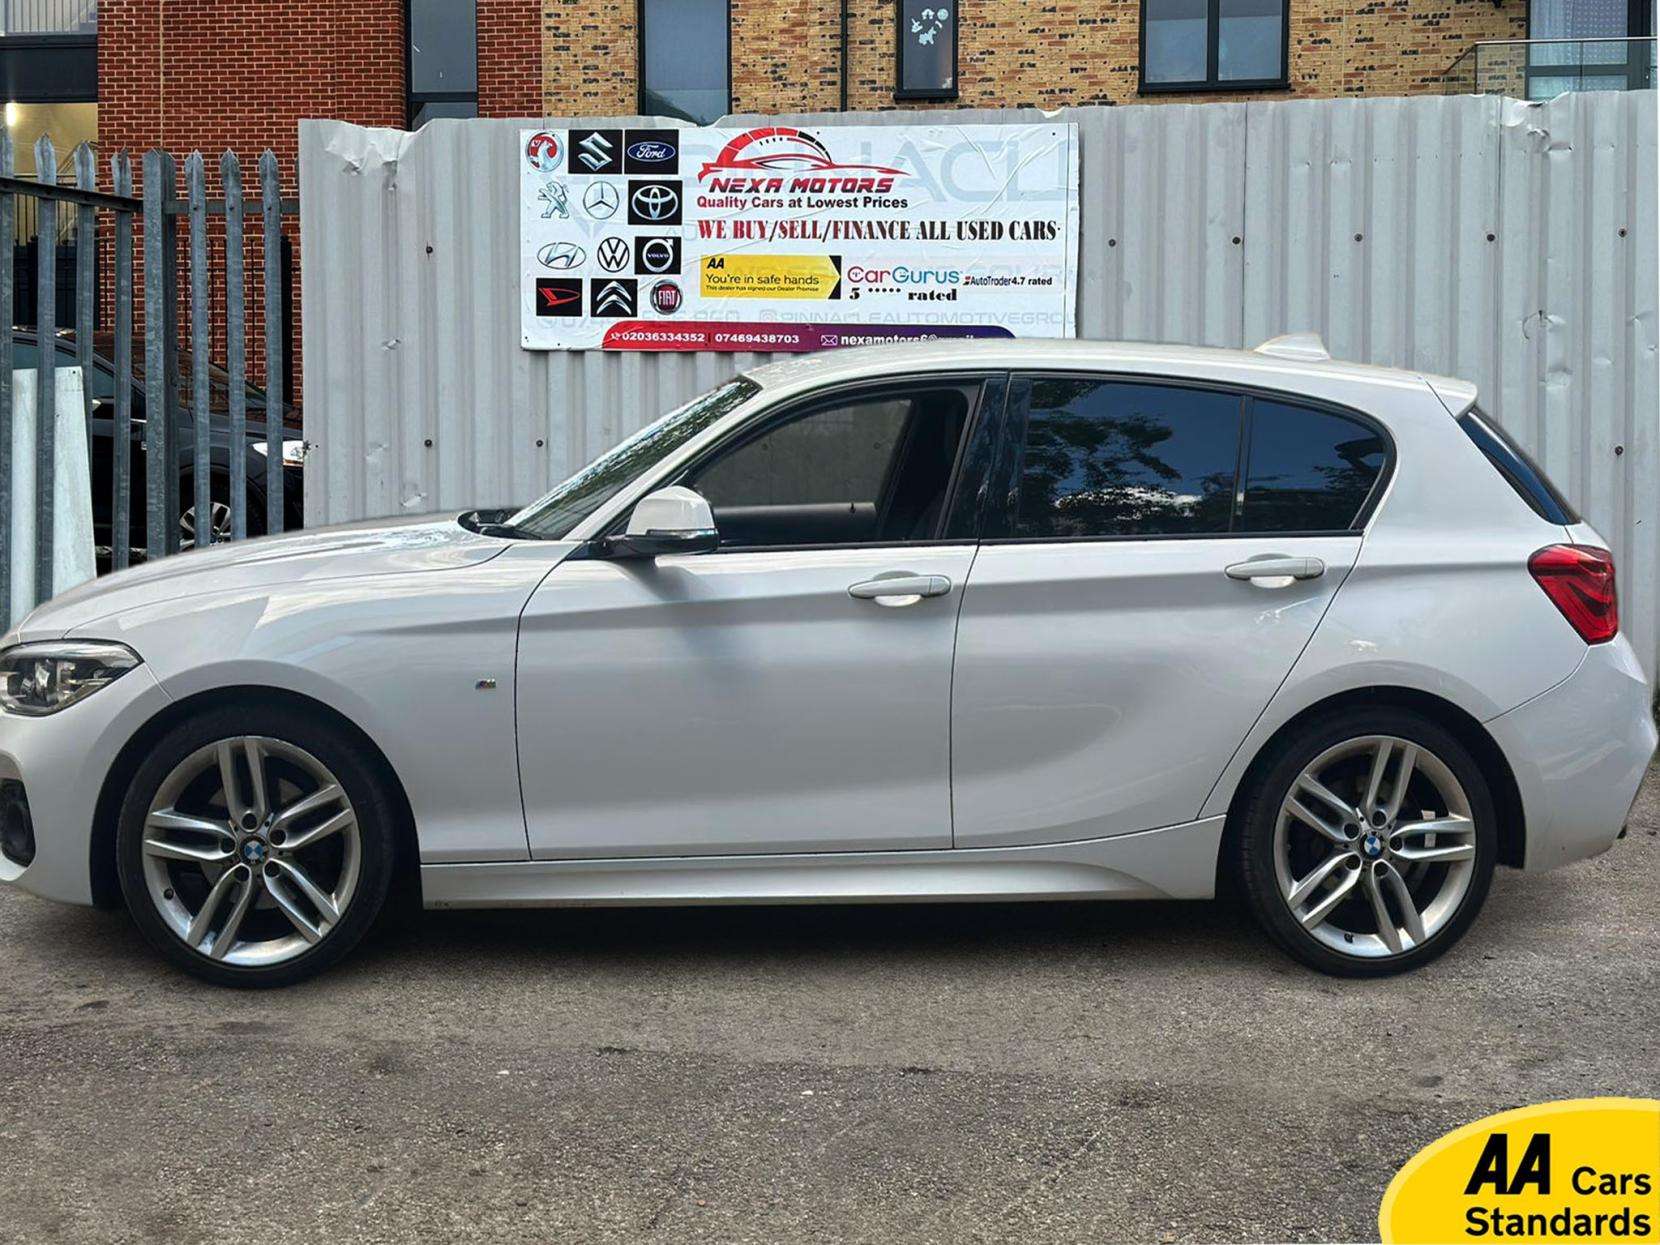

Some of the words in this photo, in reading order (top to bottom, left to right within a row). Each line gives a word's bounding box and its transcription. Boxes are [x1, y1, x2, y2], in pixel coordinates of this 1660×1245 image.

[636, 144, 666, 158] Ford
[709, 178, 784, 193] NEXA
[789, 178, 894, 193] MOTORS
[697, 196, 747, 210] Quality
[752, 196, 784, 209] Cars
[788, 197, 803, 209] at
[807, 196, 858, 209] Lowest
[863, 196, 908, 209] Prices
[697, 220, 727, 239] WE
[916, 221, 951, 240] ALL
[957, 221, 1004, 240] USED
[1009, 221, 1057, 240] CARS
[707, 257, 725, 270] AA
[706, 273, 741, 284] You're
[744, 274, 754, 284] in
[757, 274, 781, 284] safe
[784, 275, 820, 285] hands
[847, 266, 960, 284] CarGurus
[1028, 277, 1053, 286] rated
[658, 290, 677, 306] FIAT
[849, 287, 860, 300] 5
[908, 288, 957, 301] rated
[622, 333, 705, 343] 02036334352
[715, 334, 800, 344] 07469438703
